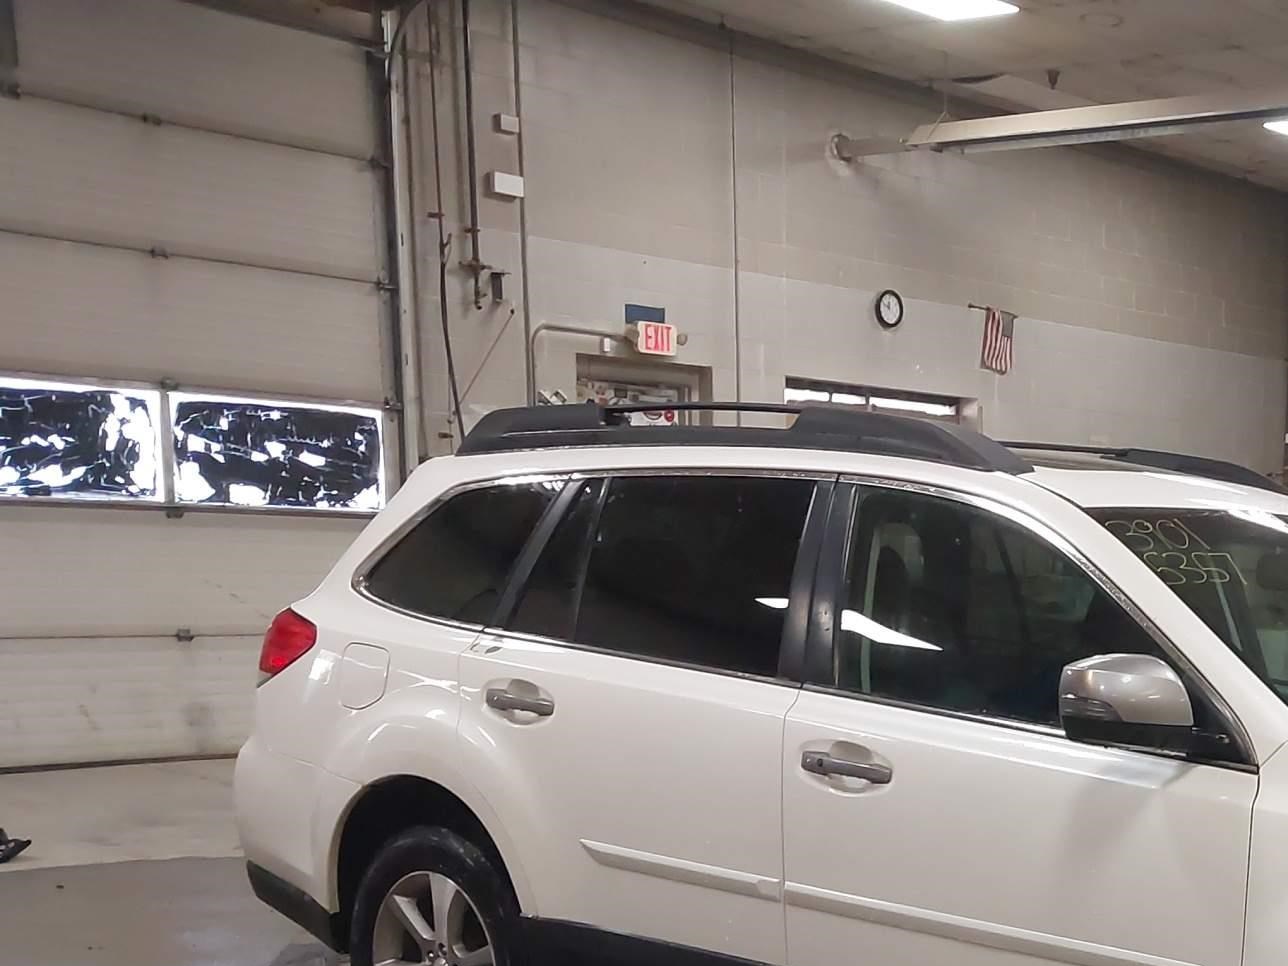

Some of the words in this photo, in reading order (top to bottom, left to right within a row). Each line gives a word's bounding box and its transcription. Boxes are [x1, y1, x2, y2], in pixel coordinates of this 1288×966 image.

[644, 323, 673, 352] EXIT
[1105, 518, 1211, 551] 3901
[1144, 551, 1247, 585] 5357
